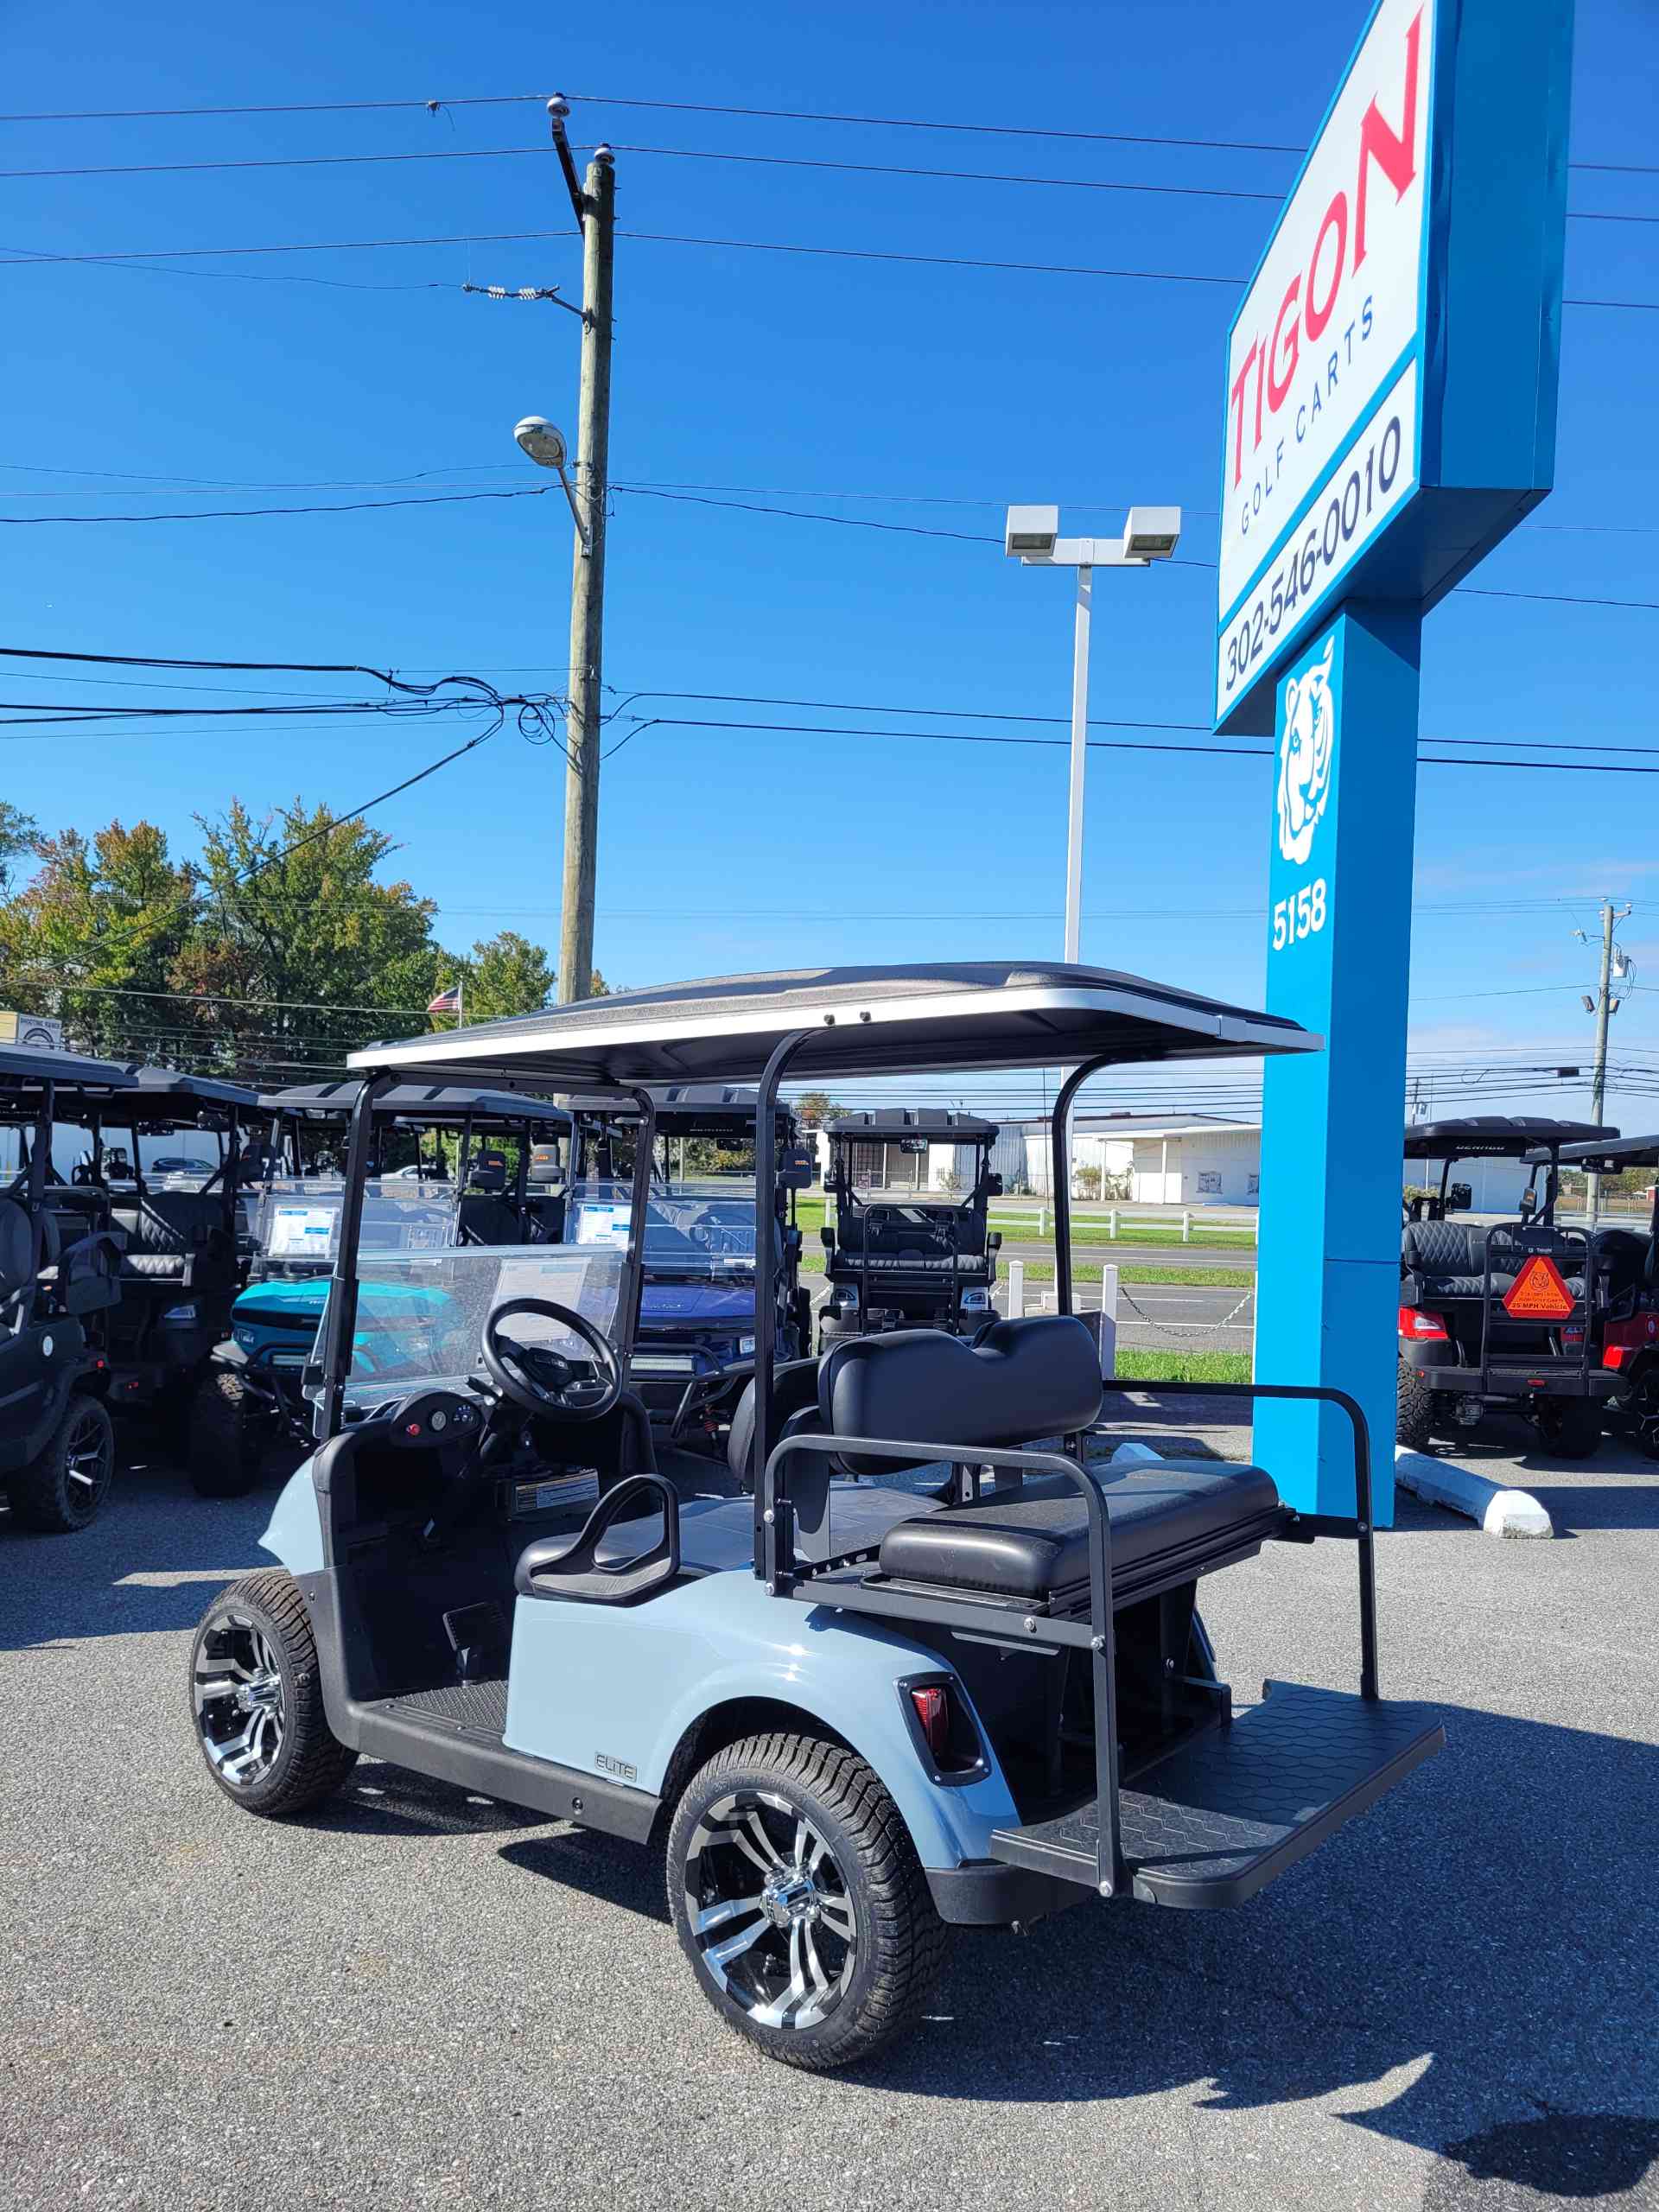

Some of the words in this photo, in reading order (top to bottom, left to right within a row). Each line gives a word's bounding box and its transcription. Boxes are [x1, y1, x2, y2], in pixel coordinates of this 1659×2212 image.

[1230, 3, 1424, 491] TIGON
[1242, 436, 1284, 535] GOLF
[1296, 295, 1372, 443] CARTS
[1226, 416, 1401, 691] 302-546-0010
[1273, 878, 1326, 950] 5158
